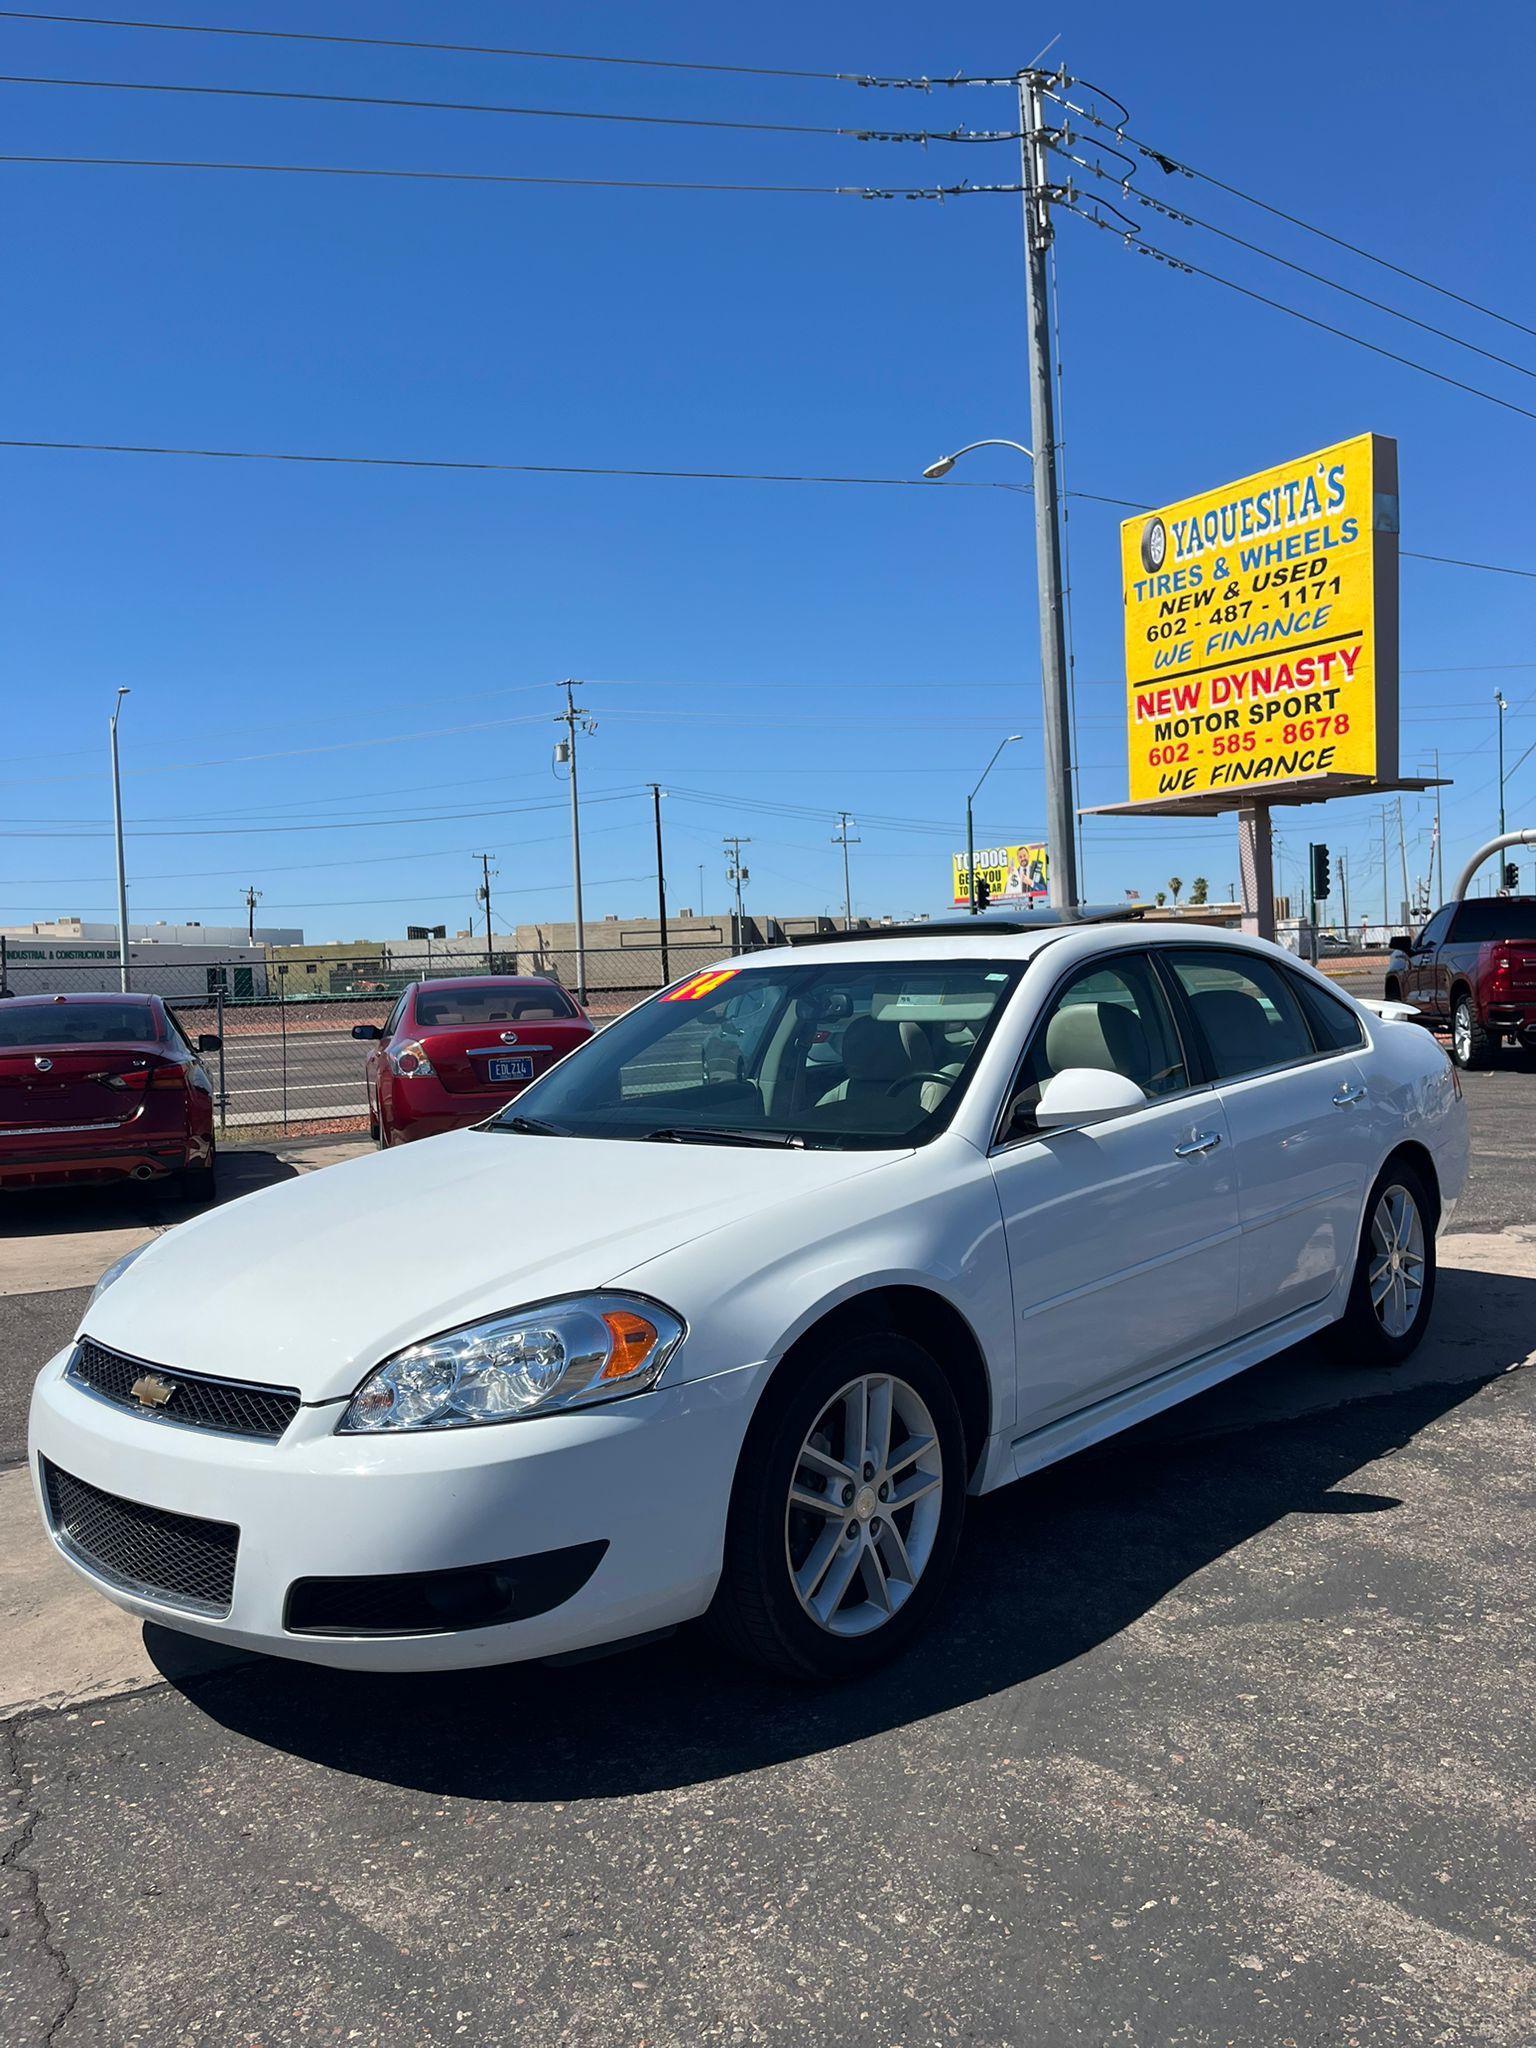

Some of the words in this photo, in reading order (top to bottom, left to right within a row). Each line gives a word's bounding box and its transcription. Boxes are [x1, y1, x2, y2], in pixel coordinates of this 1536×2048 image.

[1171, 463, 1345, 561] YAQUESITA'S
[1133, 564, 1203, 602] TIRES
[1213, 556, 1230, 581] &
[1240, 517, 1359, 573] WHEELS
[1159, 587, 1216, 618] NEW
[1223, 581, 1240, 601] &
[1252, 557, 1328, 593] USED
[1146, 617, 1187, 643] 602
[1209, 600, 1253, 625] 487
[1279, 576, 1341, 608] 1171
[1153, 640, 1194, 670] WE
[1206, 604, 1333, 657] FINANCE
[1135, 681, 1202, 723] NEW
[1209, 645, 1362, 709] DYNASTY
[1148, 742, 1190, 767] 602
[1212, 731, 1256, 757] 585
[1283, 713, 1350, 745] 8678
[1154, 709, 1240, 742] MOTOR
[1248, 688, 1341, 726] SPORT
[1158, 767, 1199, 794] WE
[1209, 745, 1336, 786] FINANCE
[958, 872, 981, 885] GES
[983, 869, 1002, 883] YOU
[6, 950, 47, 960] NDUSTRIAL
[49, 950, 55, 960] &
[56, 950, 105, 960] CONSTRUCTION
[106, 950, 120, 960] SUP
